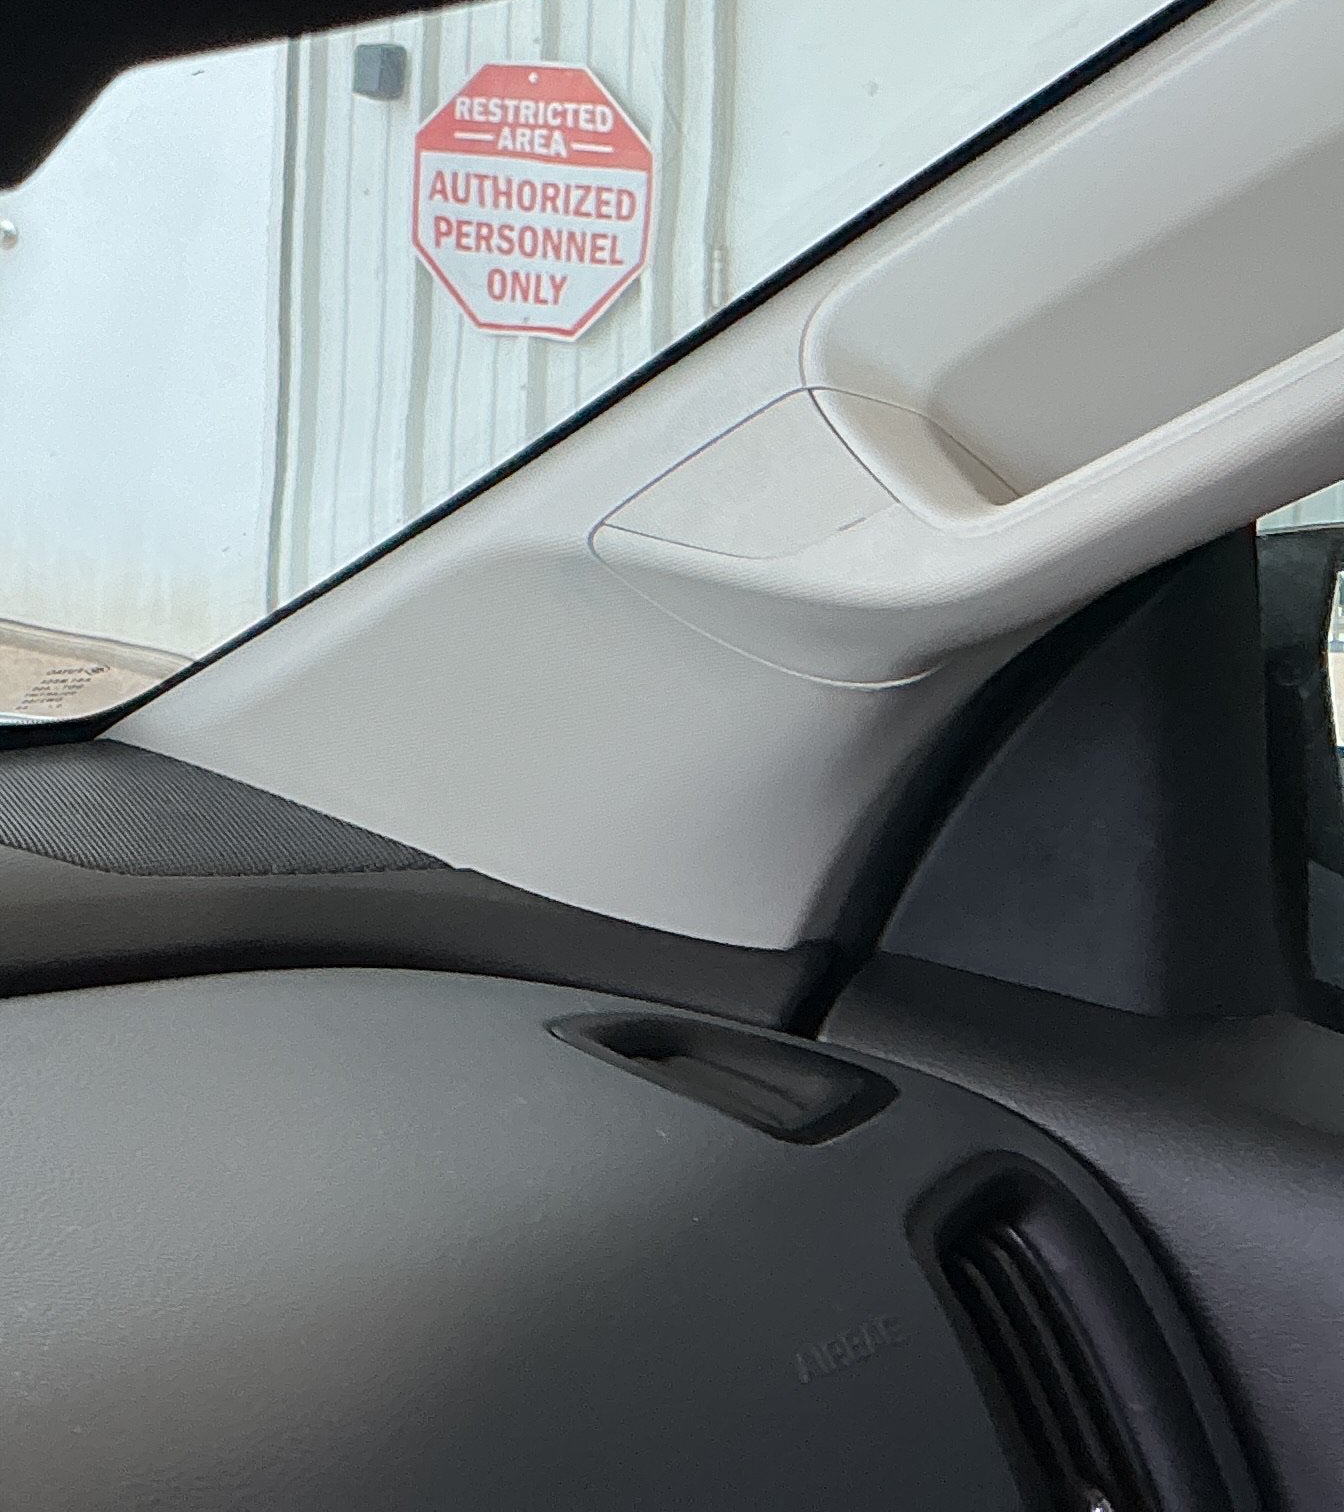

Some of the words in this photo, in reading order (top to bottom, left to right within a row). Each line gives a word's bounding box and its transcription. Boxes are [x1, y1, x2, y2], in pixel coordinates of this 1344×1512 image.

[454, 96, 614, 133] RESTRICTED
[497, 129, 567, 158] AREA
[428, 170, 637, 222] AUTHORIZED
[433, 216, 624, 266] PERSONNEL
[486, 268, 568, 306] ONLY
